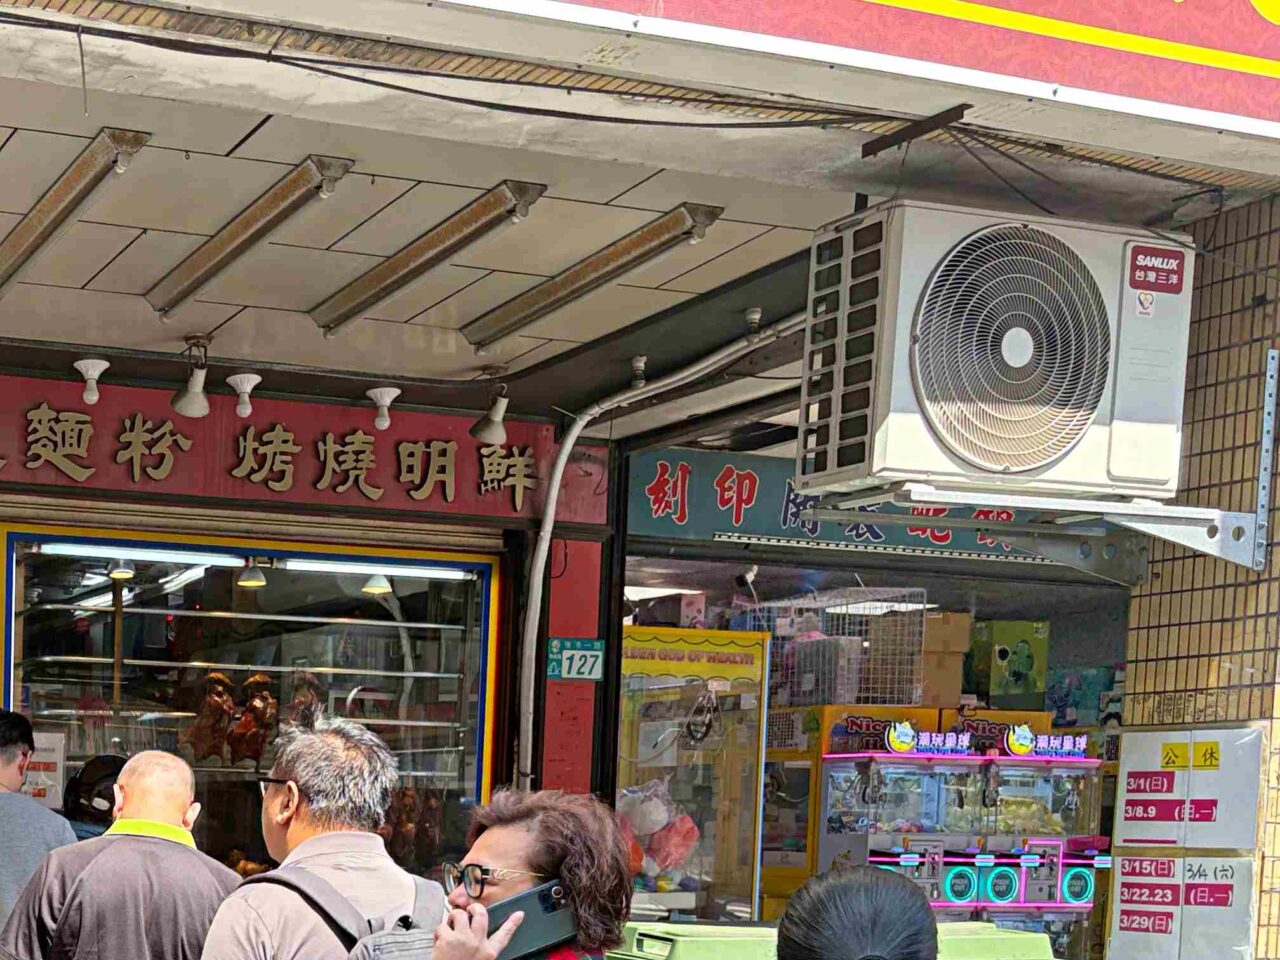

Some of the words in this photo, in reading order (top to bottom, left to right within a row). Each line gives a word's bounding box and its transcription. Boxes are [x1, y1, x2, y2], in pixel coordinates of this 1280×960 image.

[1135, 254, 1180, 270] SANLUX
[1135, 269, 1179, 285] 台灣三洋
[565, 653, 600, 676] 127
[1126, 776, 1168, 791] 3/1(日)
[1124, 805, 1157, 818] 3/8.9
[1121, 859, 1175, 876] 3/15(日)
[1120, 887, 1173, 902] 3/22.23
[1119, 915, 1173, 932] 3/29(日)
